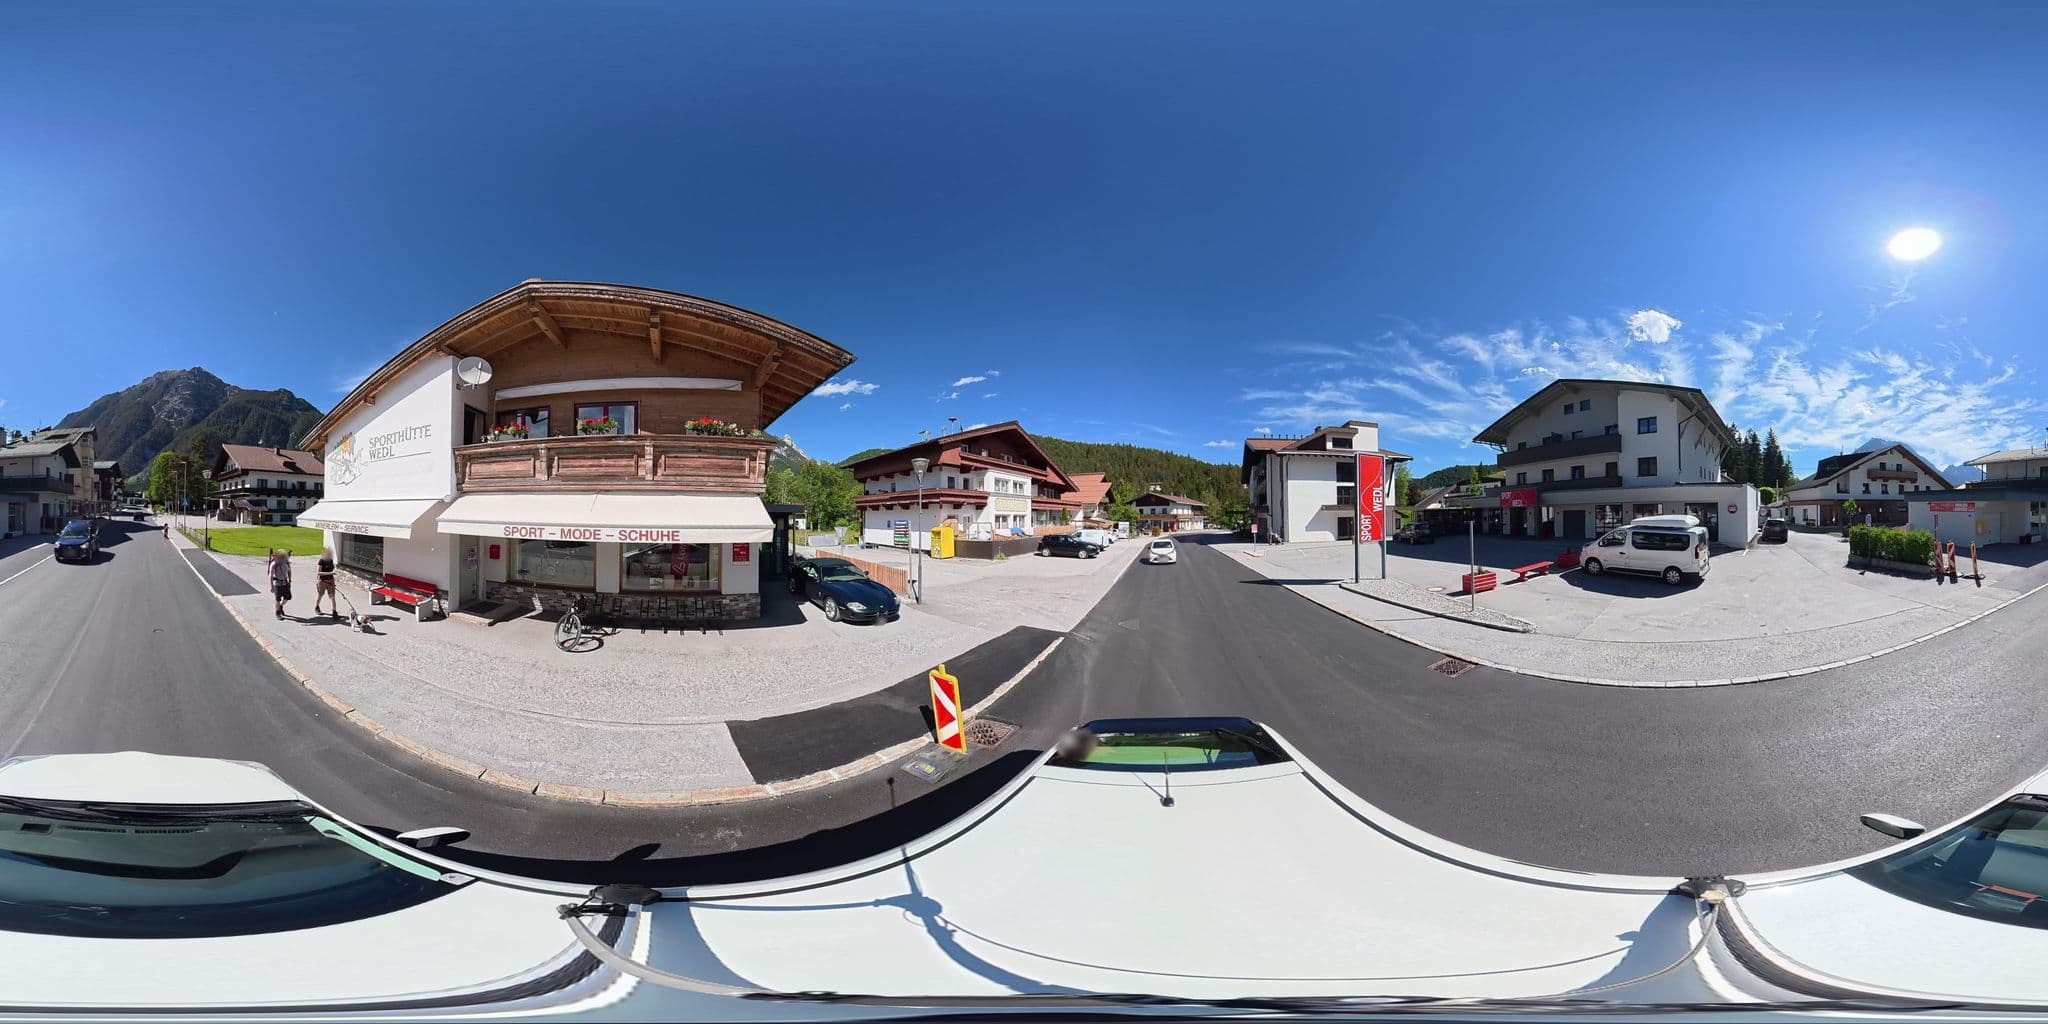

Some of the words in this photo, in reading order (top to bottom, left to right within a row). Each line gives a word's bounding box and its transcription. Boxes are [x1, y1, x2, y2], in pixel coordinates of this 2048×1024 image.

[368, 424, 432, 449] SPORTHÜTTE
[368, 446, 396, 460] WEDL
[1372, 486, 1383, 512] WEDL
[344, 524, 369, 534] SERVICE
[503, 526, 545, 538] SPORT
[560, 528, 602, 540] MODE
[618, 530, 681, 542] SCHUHE
[1361, 514, 1372, 541] SPORT
